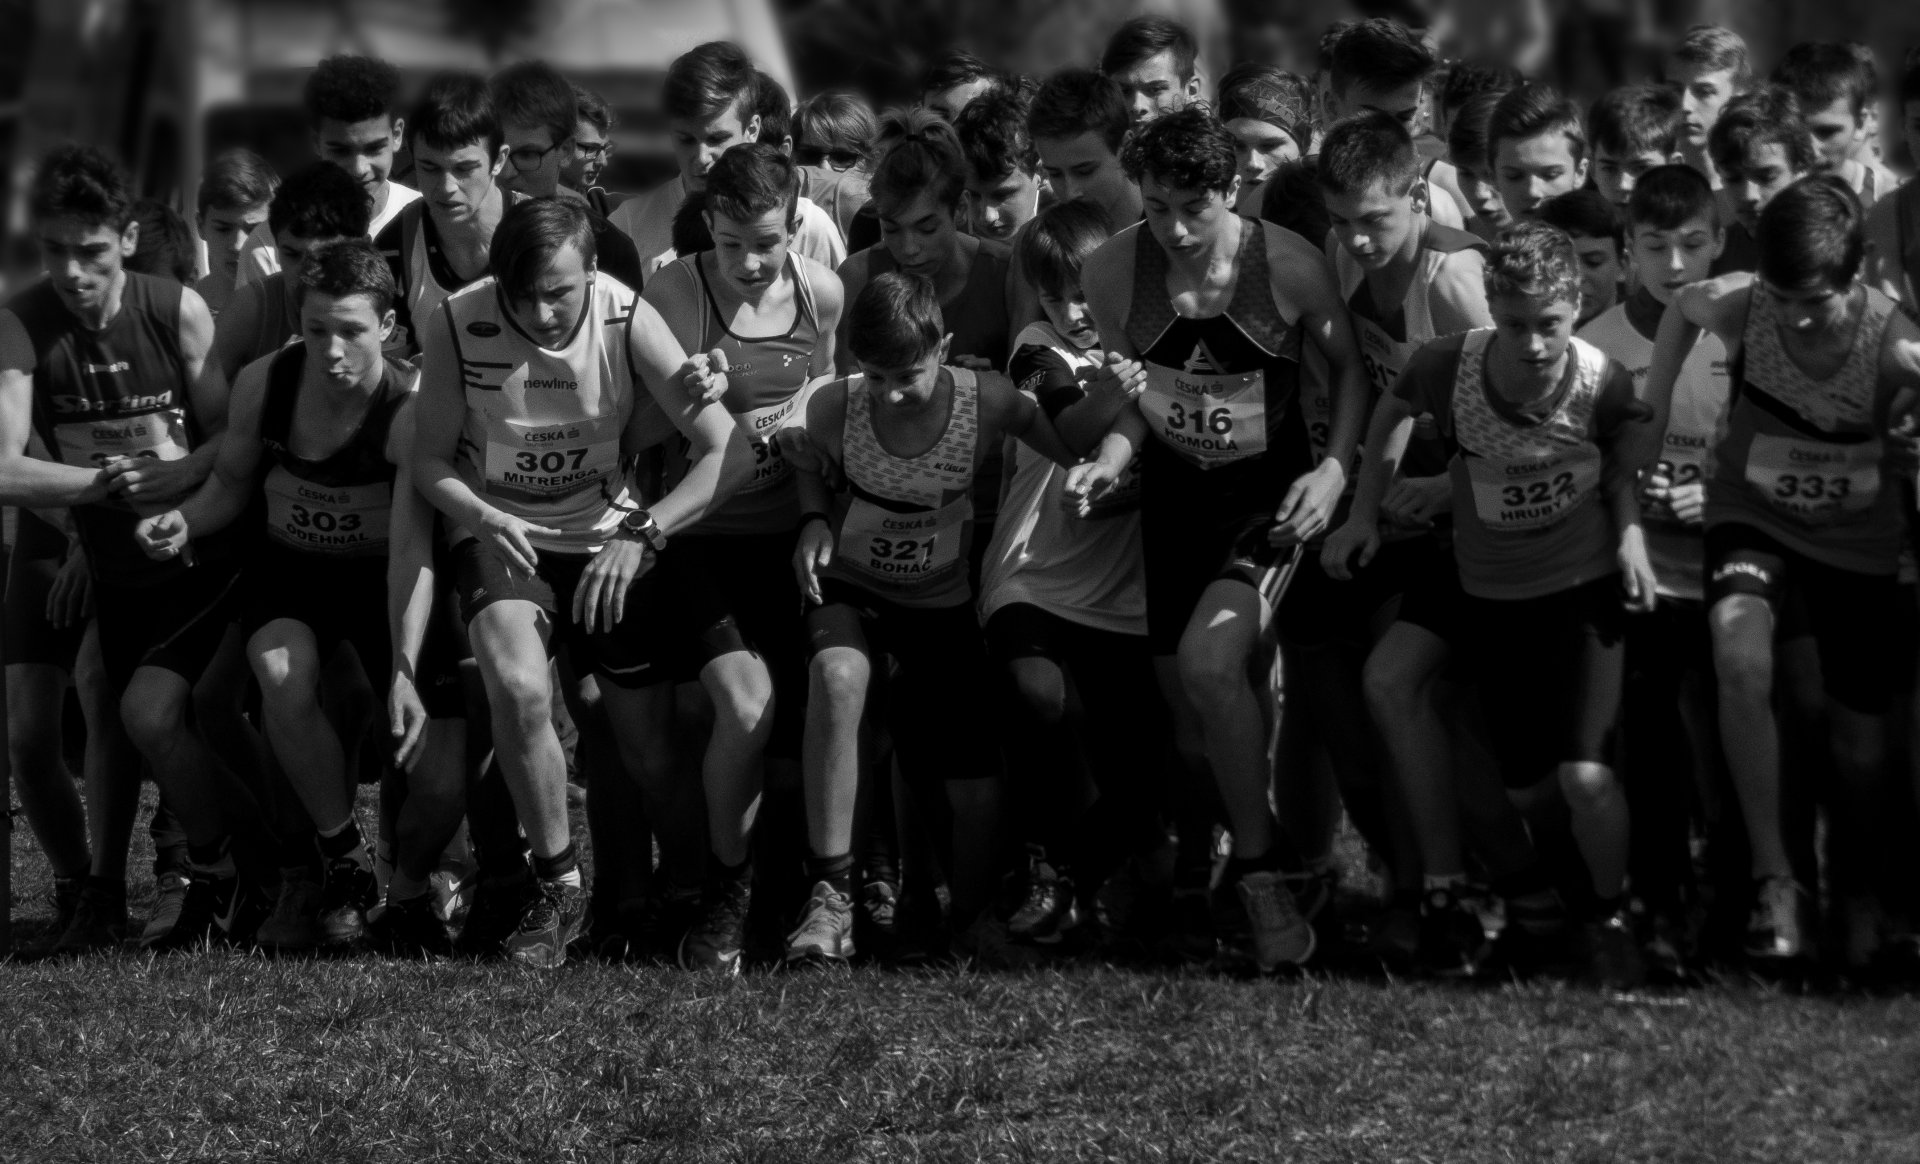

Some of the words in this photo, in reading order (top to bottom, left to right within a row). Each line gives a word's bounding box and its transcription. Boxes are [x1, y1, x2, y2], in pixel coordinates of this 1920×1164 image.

[523, 377, 578, 391] newline
[755, 406, 786, 430] ČESKÁ
[1167, 401, 1233, 435] 316
[524, 429, 565, 442] ČESKÁ
[1164, 427, 1239, 451] HOMOLA
[515, 447, 589, 473] 307
[503, 468, 599, 486] MITRENGA
[1502, 471, 1574, 507] 322
[1774, 474, 1850, 499] 333
[291, 504, 362, 532] 303
[286, 522, 369, 545] ODEHNAL
[870, 536, 937, 560] 321
